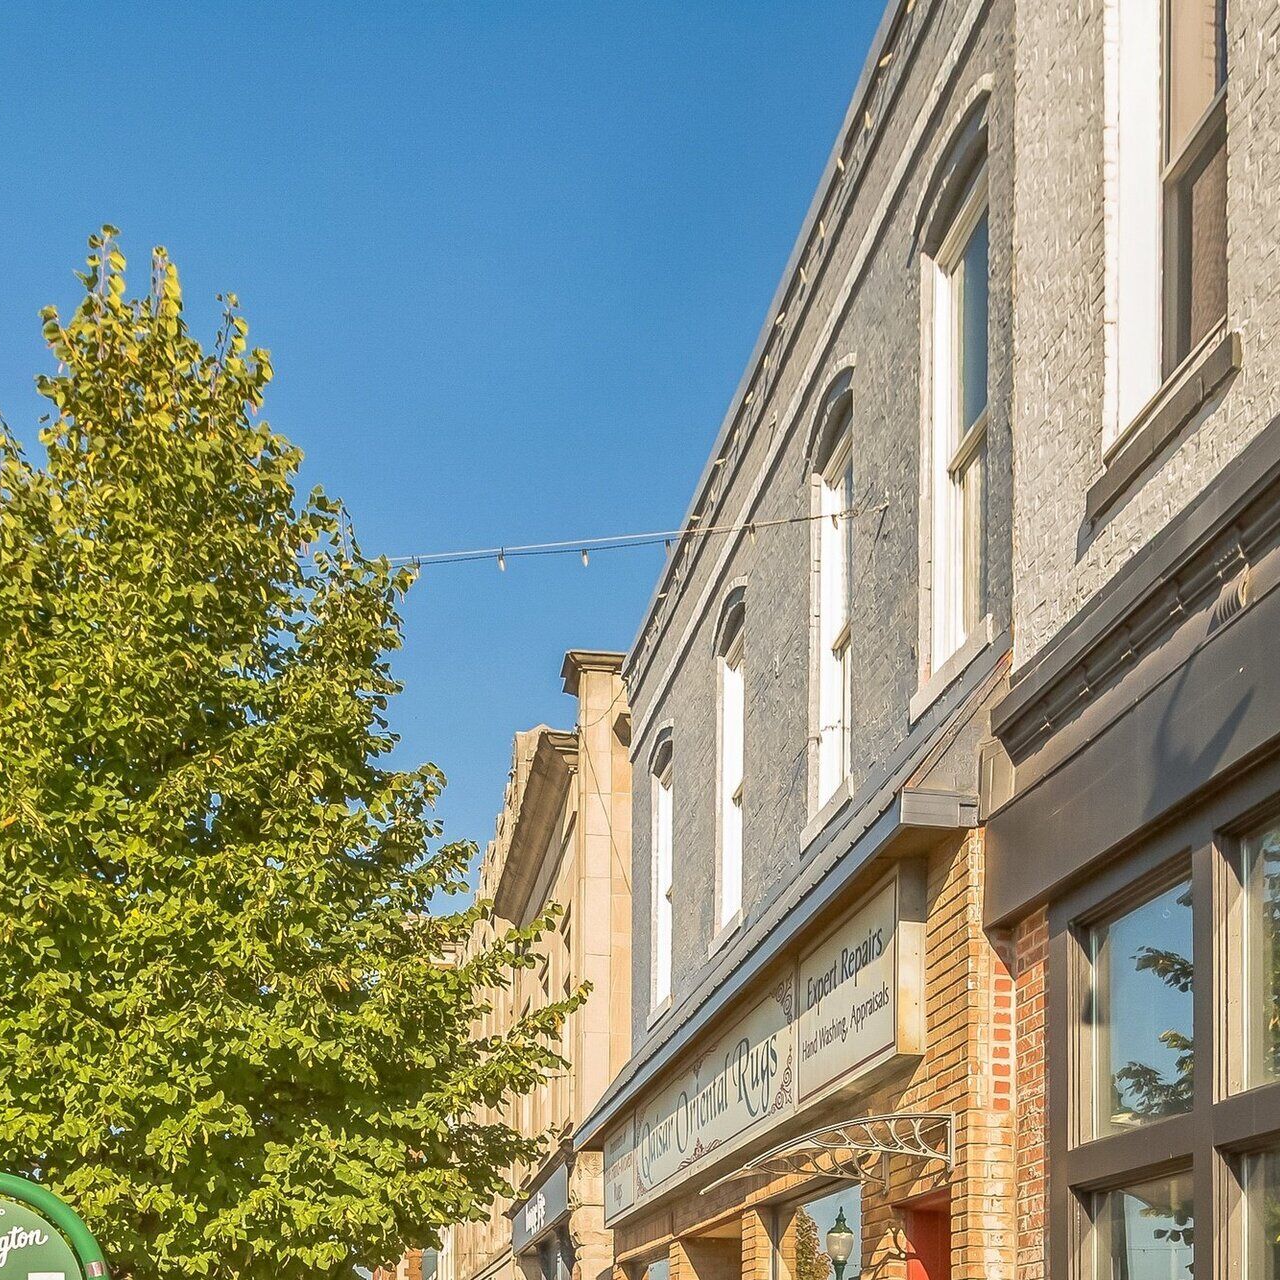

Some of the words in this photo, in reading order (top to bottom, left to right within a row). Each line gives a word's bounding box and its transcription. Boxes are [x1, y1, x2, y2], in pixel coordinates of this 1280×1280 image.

[807, 960, 838, 1016] Expert
[840, 927, 883, 987] Repairs
[802, 1030, 818, 1062] Hand
[850, 981, 890, 1033] Appraisals
[641, 1113, 674, 1185] Qaisar
[676, 1052, 730, 1154] Oriental
[732, 1034, 778, 1118] Rugs
